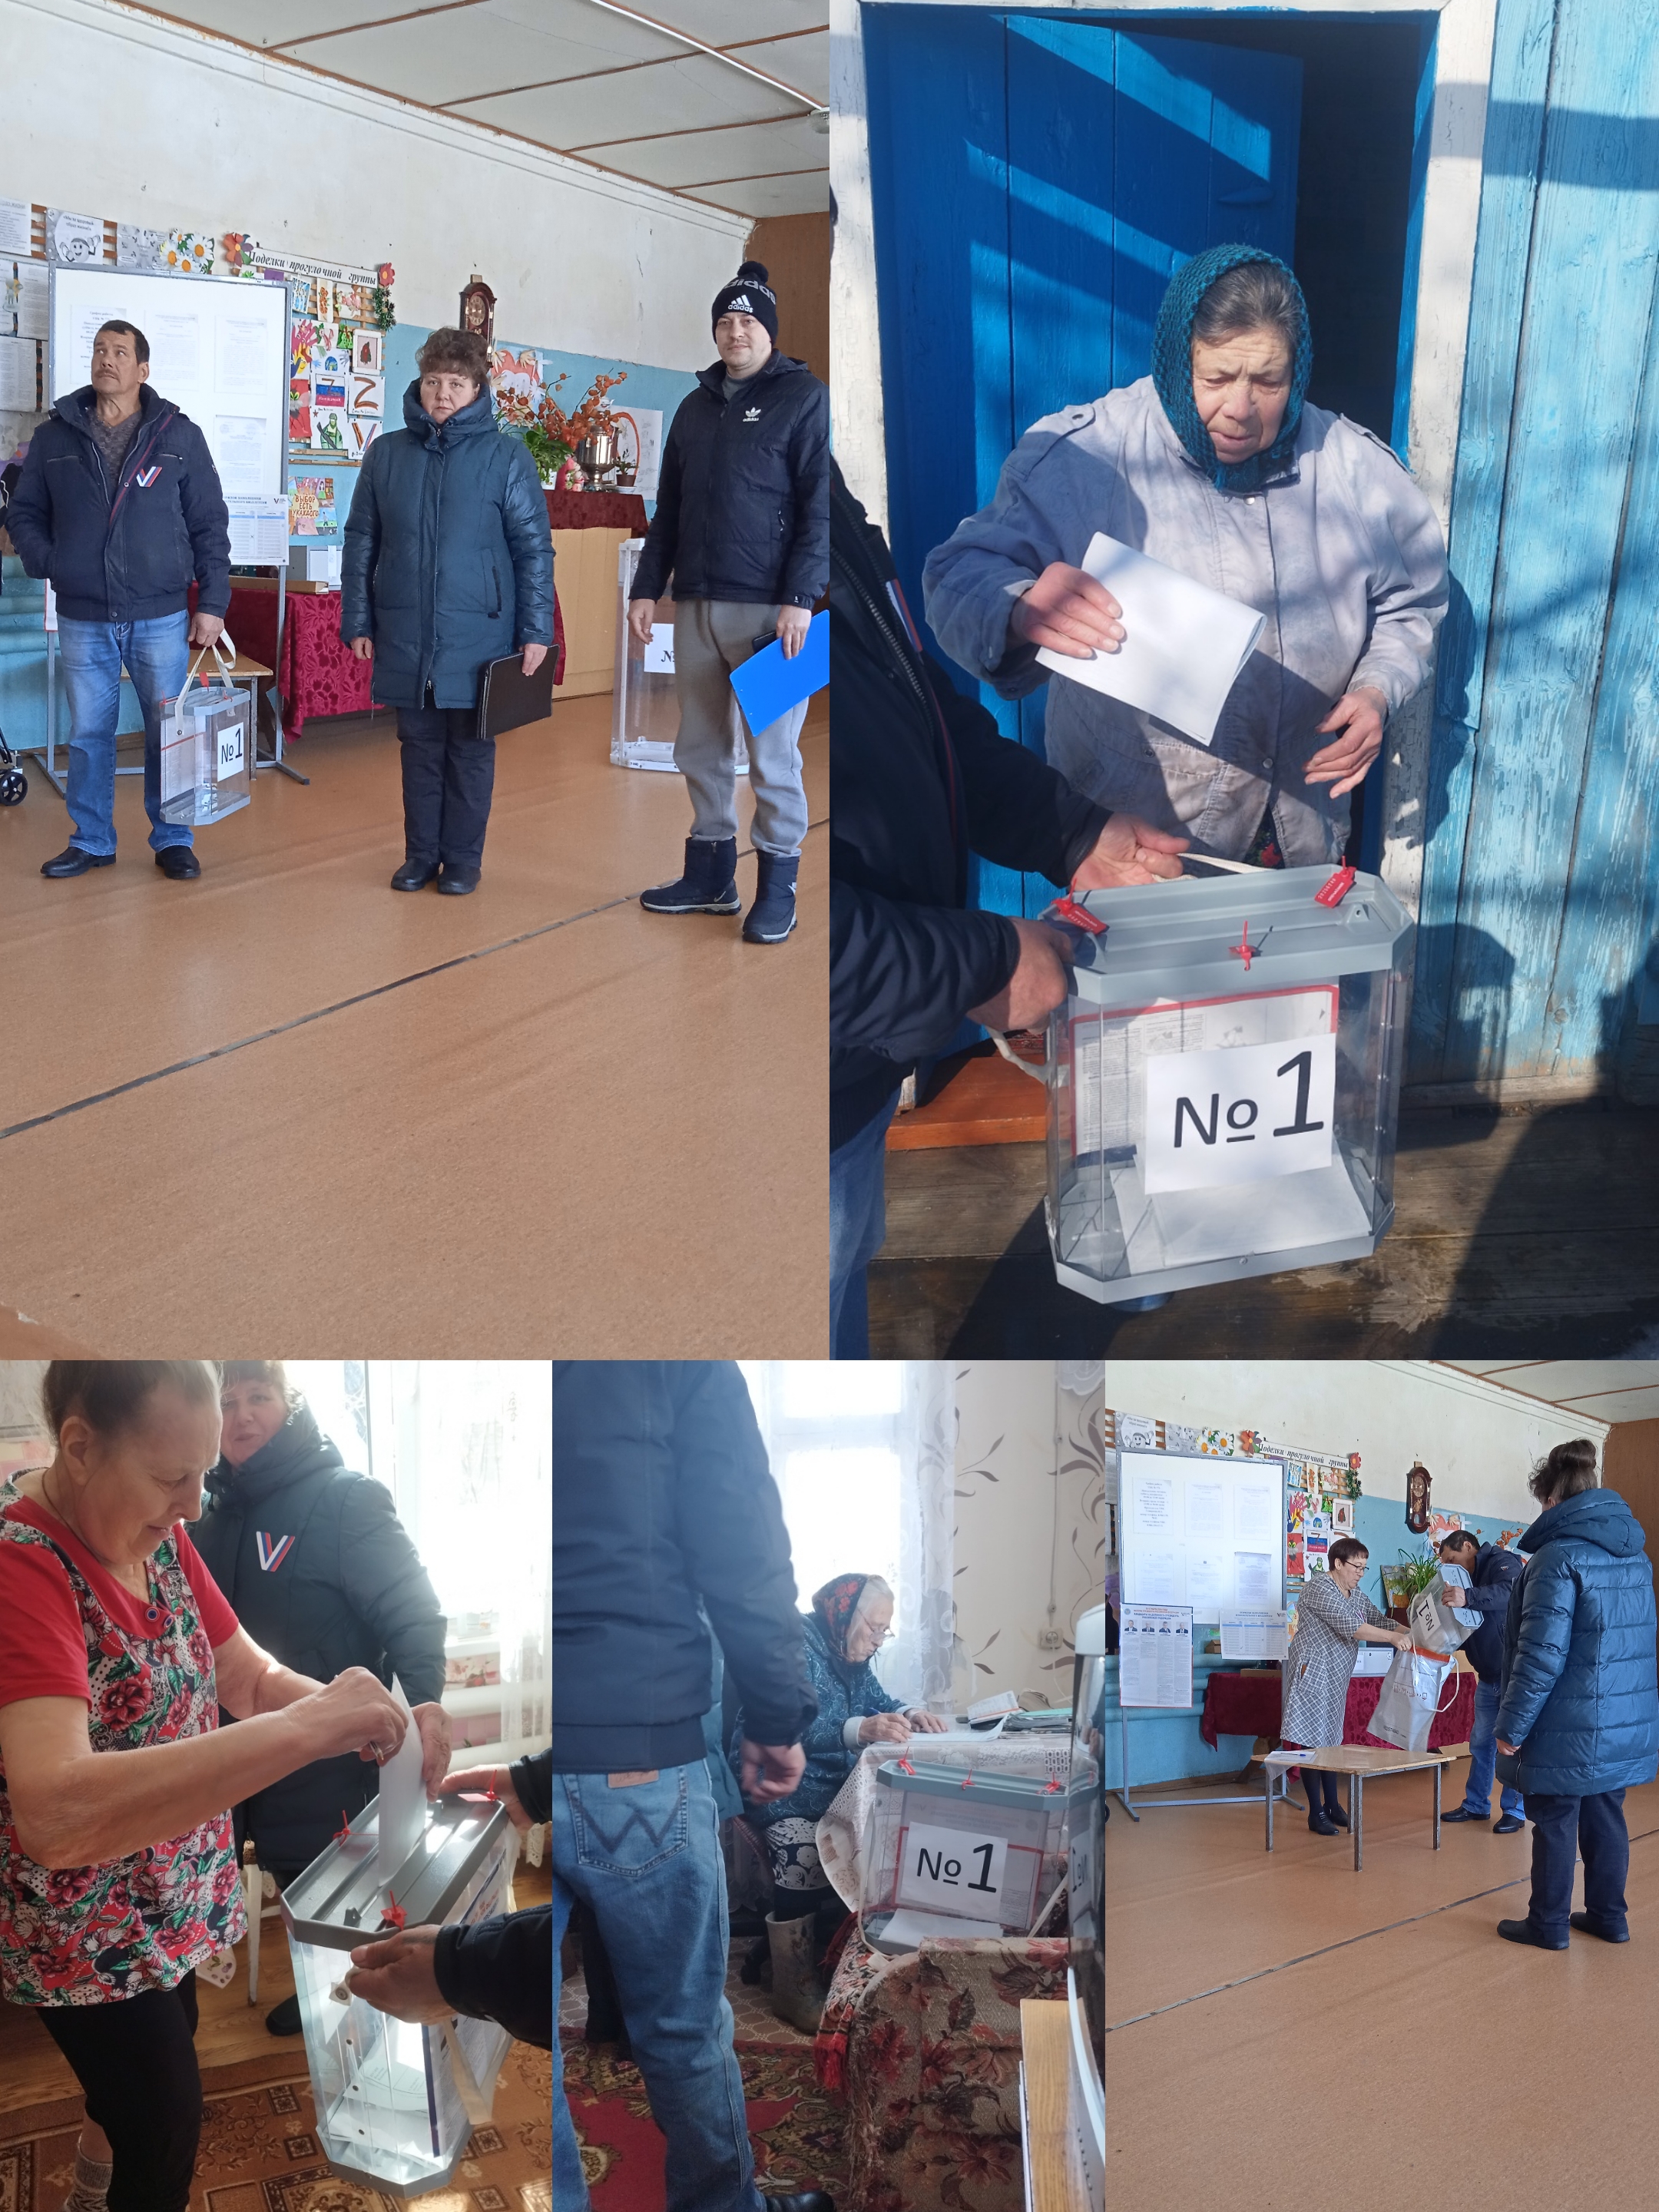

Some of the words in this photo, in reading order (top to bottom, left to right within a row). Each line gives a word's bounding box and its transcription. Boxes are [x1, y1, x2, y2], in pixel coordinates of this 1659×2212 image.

[248, 251, 285, 268] Поделки
[348, 272, 376, 286] группы
[724, 278, 776, 305] didas
[727, 303, 753, 313] adidas
[353, 376, 379, 411] Z
[295, 495, 316, 503] ВЫБОР
[220, 727, 243, 766] №1
[1173, 1049, 1325, 1150] №1
[1328, 1459, 1349, 1469] группы
[916, 1842, 998, 1894] №1
